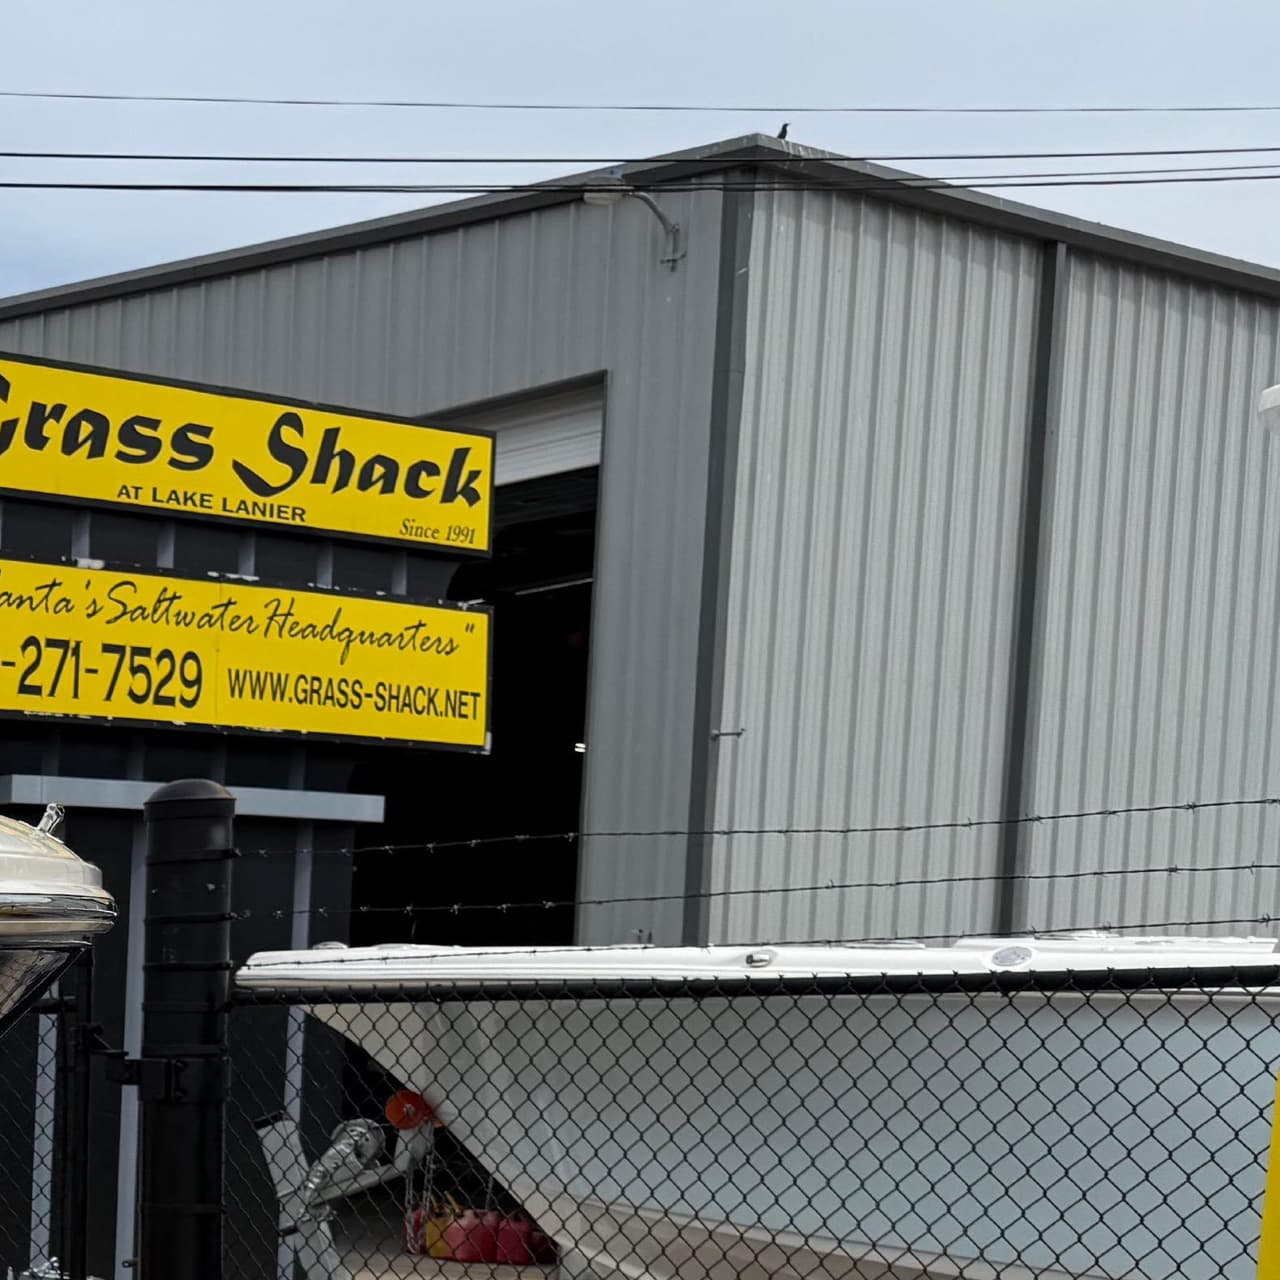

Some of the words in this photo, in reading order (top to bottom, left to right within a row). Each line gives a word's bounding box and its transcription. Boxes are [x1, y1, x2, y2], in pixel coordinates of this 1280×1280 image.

[232, 412, 482, 508] Shack
[117, 484, 143, 501] AT
[151, 487, 214, 510] LAKE
[222, 496, 307, 523] LANIER
[399, 518, 440, 541] Since
[445, 524, 476, 545] 1991
[105, 580, 260, 635] Saltwater
[227, 668, 481, 720] WWW.GRASS-SHACK.NET
